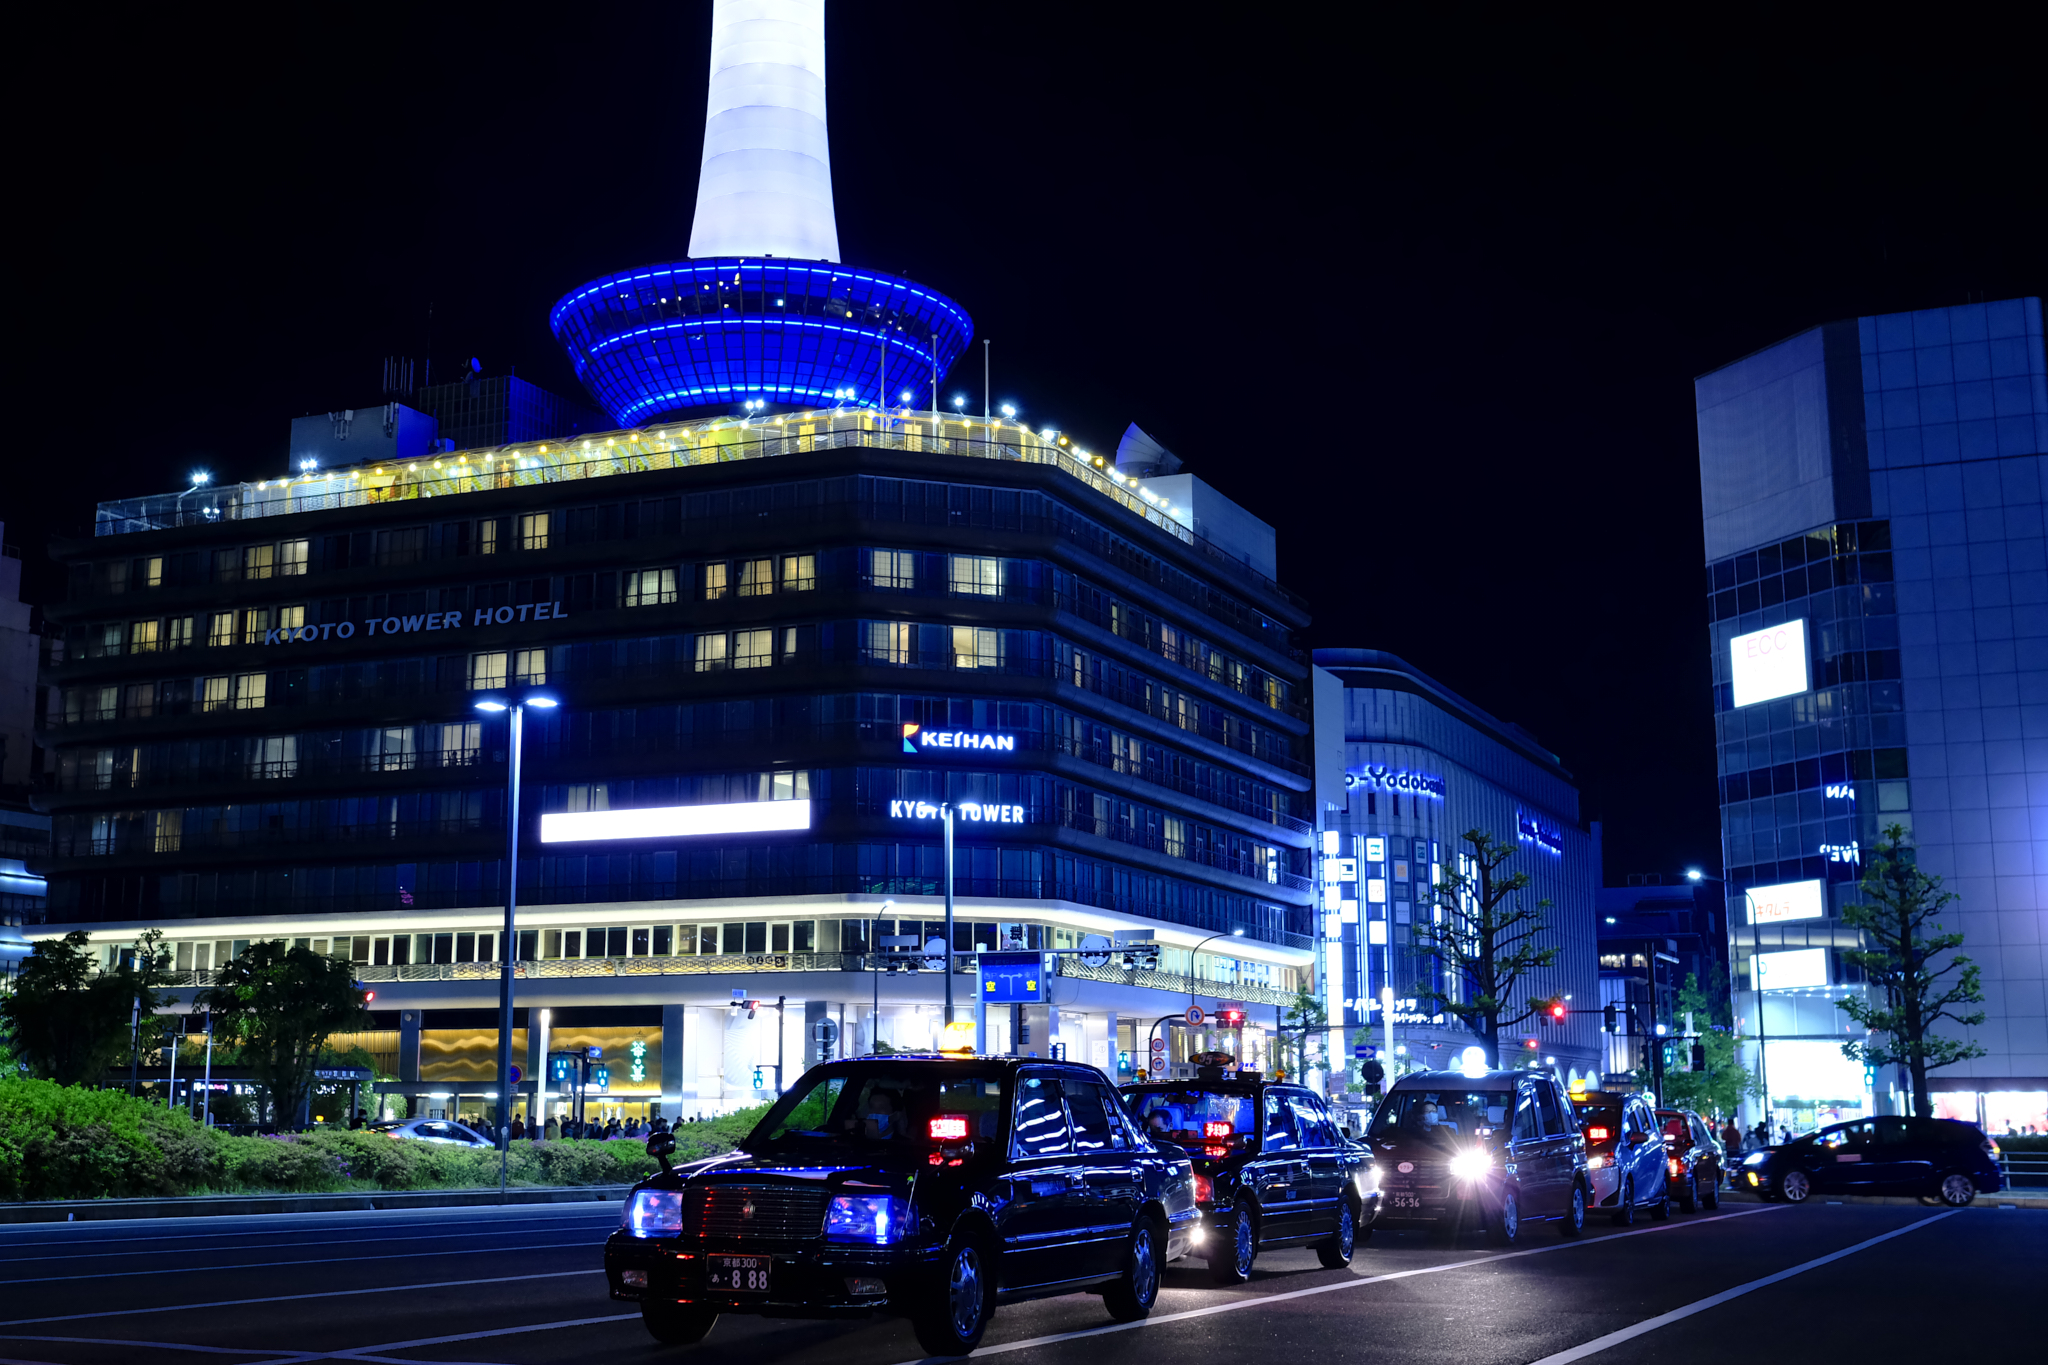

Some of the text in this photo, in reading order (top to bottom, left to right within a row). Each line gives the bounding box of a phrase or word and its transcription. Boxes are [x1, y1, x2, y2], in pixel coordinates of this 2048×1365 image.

[264, 601, 568, 646] KYOTO TOWER HOTEL
[1747, 630, 1787, 658] ECC
[921, 731, 1014, 750] KEIHAN
[1756, 902, 1790, 917] キタムラ
